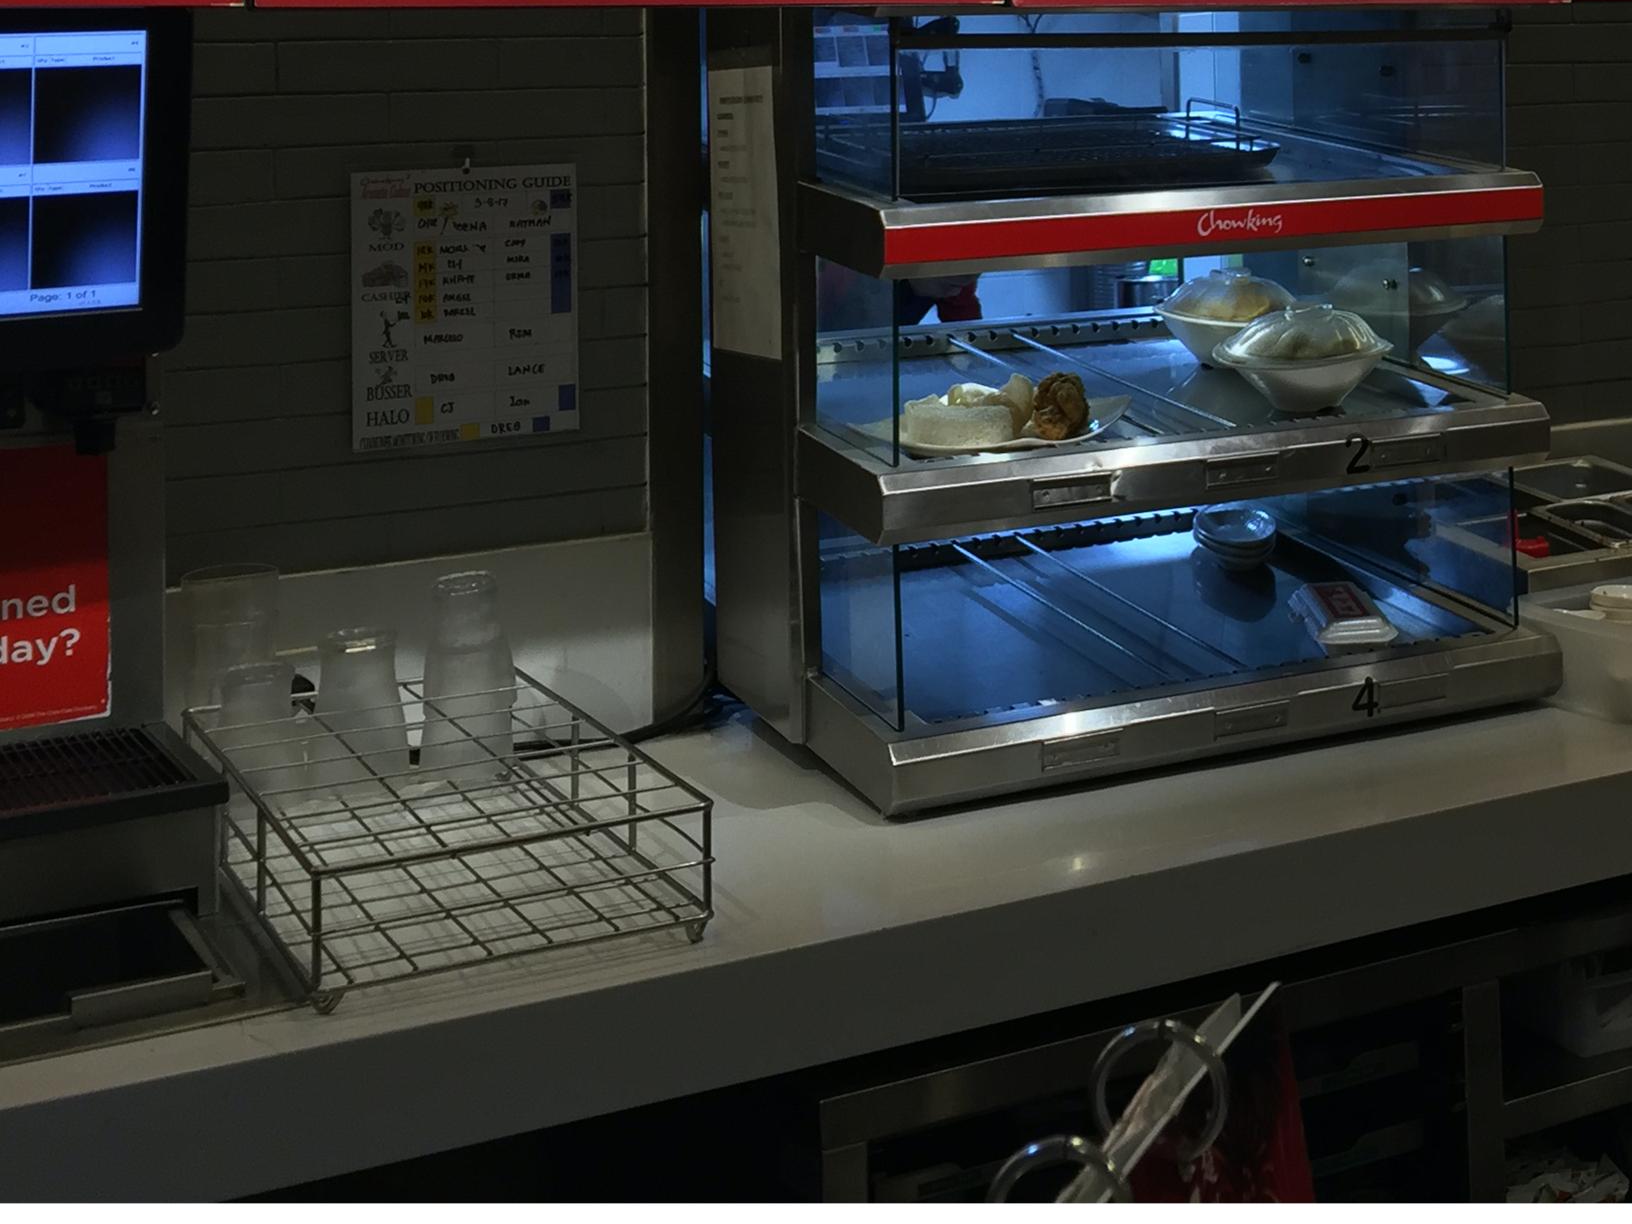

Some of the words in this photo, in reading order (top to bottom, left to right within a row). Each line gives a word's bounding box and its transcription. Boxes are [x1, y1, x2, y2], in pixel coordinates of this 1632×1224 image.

[414, 179, 518, 194] POSITIONING
[522, 176, 572, 189] GUIDE
[1196, 208, 1283, 237] Chowking
[368, 242, 405, 252] MOD
[30, 293, 62, 304] Page:
[76, 290, 87, 299] of
[368, 349, 409, 364] SERVER
[507, 363, 545, 376] LANCE
[366, 384, 413, 401] BUSSER
[366, 408, 410, 427] HALO
[1344, 434, 1372, 475] 2
[1352, 677, 1379, 716] 4
